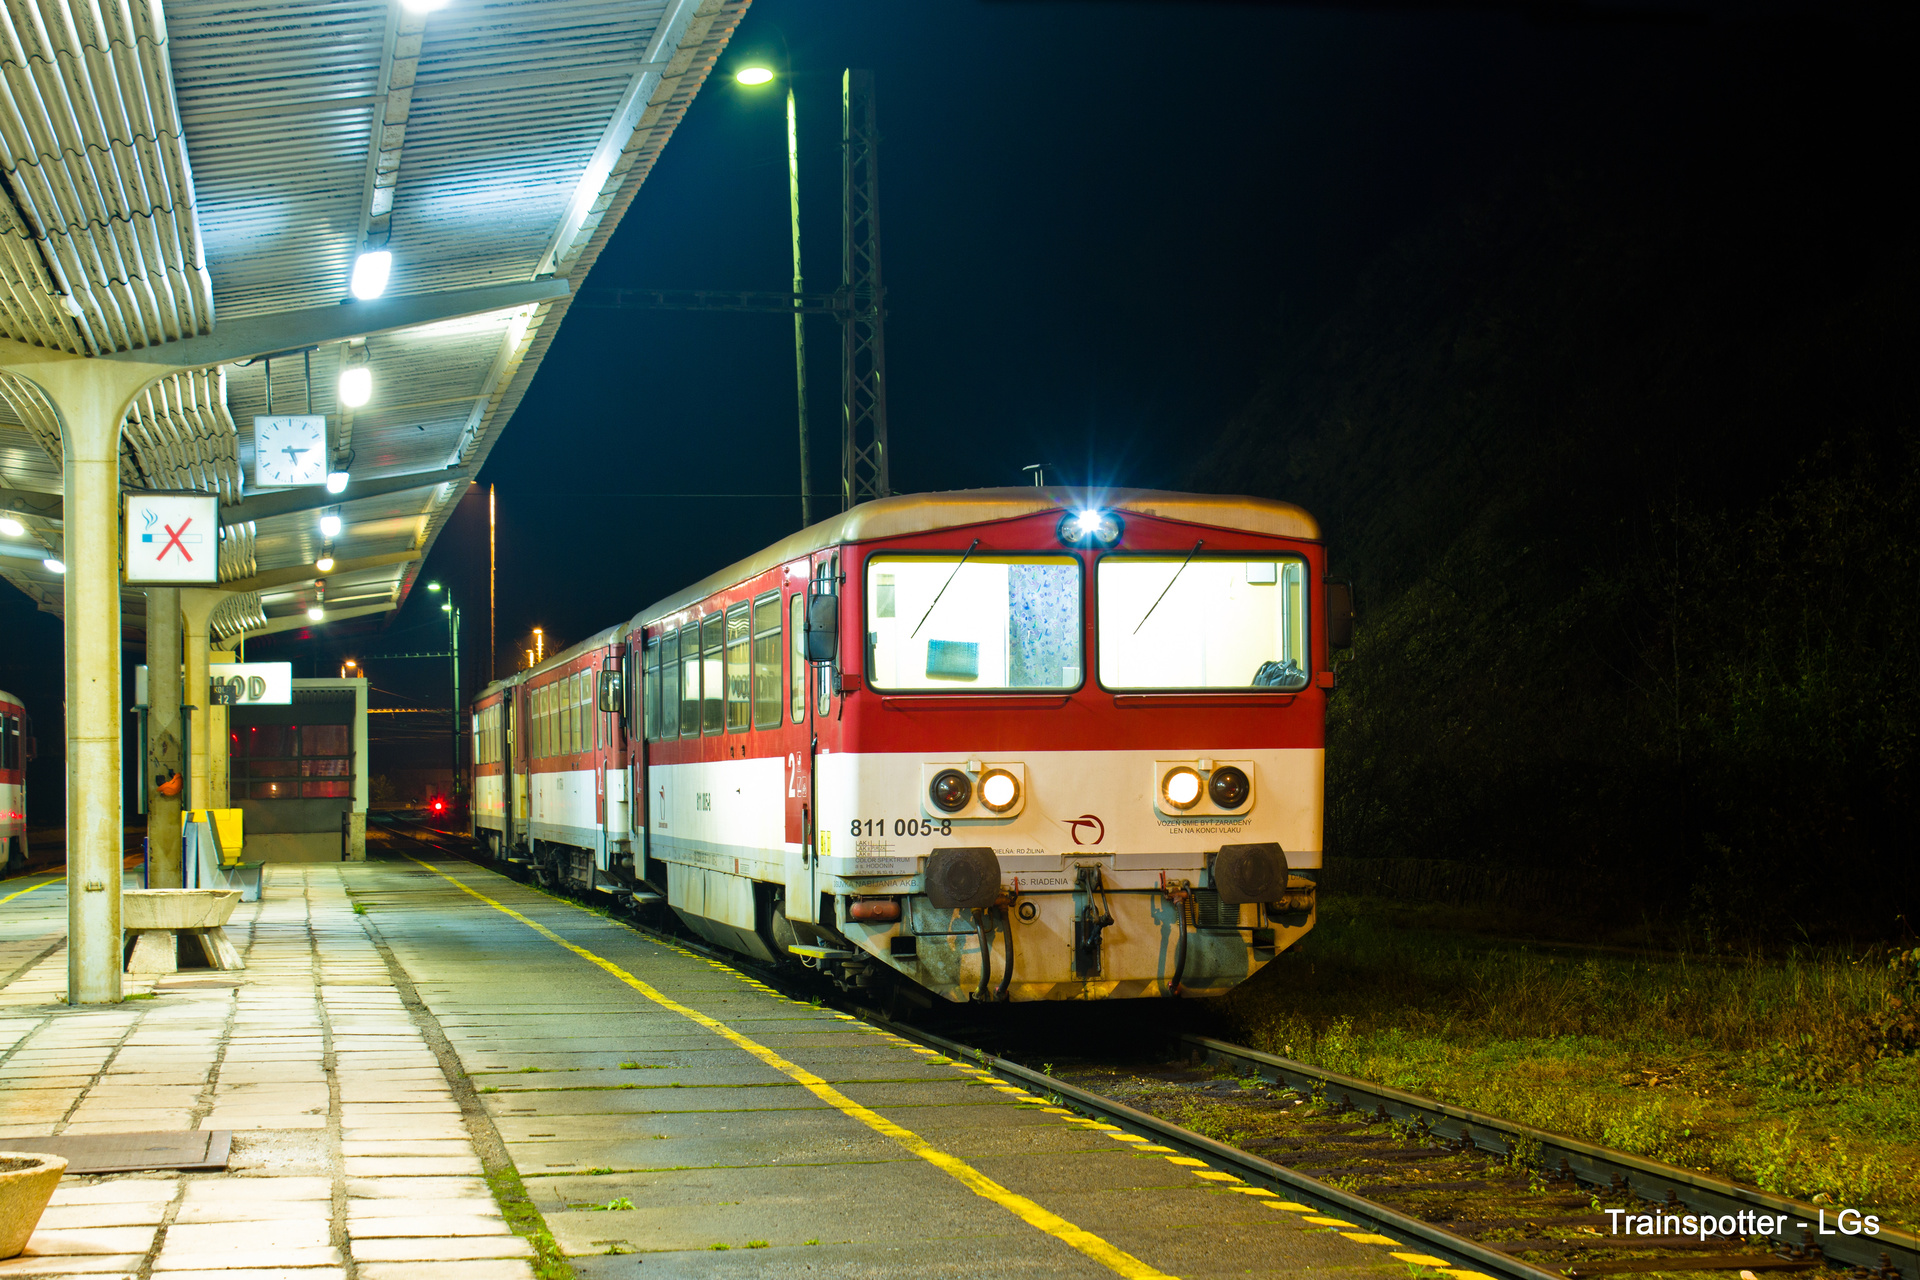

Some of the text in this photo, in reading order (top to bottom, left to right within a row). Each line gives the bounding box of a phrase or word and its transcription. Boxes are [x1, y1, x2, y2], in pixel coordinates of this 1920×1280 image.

[787, 752, 796, 798] 2
[1157, 819, 1180, 827] VOZEŇ
[850, 819, 952, 837] 811 005-8
[899, 879, 919, 887] AKB.
[1030, 878, 1069, 886] RIADENIA
